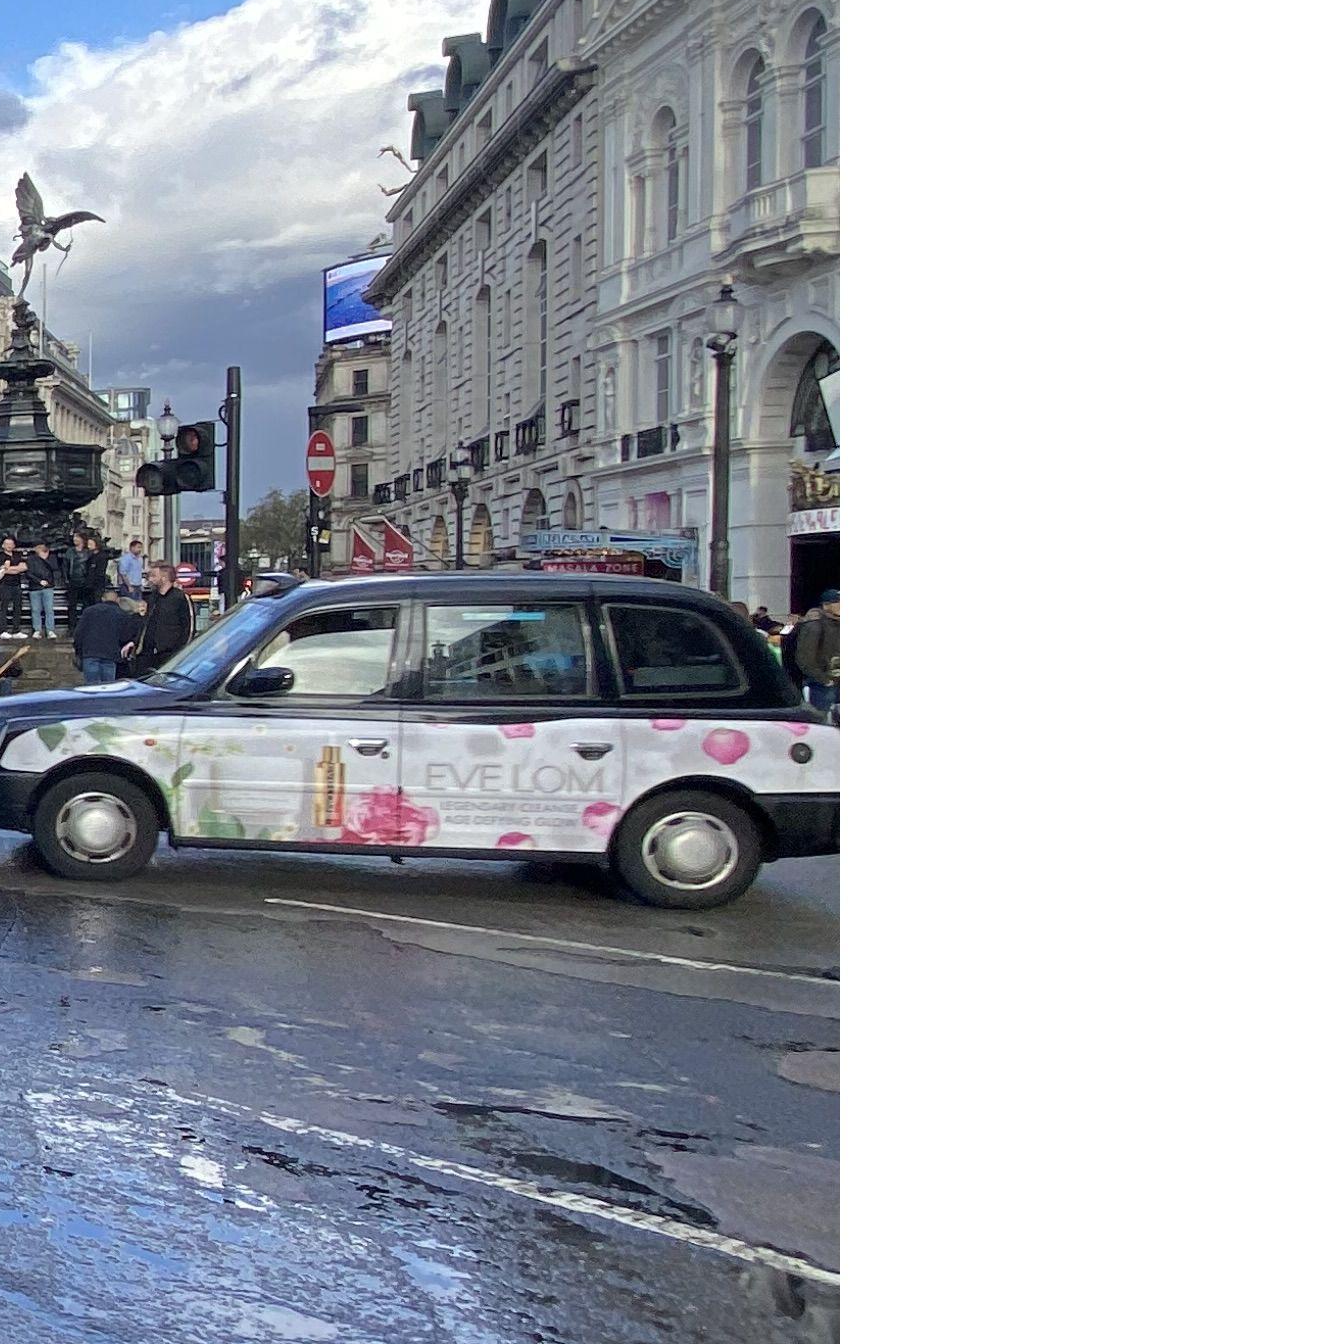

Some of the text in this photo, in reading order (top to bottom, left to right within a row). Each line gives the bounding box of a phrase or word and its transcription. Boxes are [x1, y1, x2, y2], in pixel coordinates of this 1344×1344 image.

[605, 562, 639, 573] ZONE
[425, 762, 605, 794] EVE LOM
[444, 814, 472, 825] AGE
